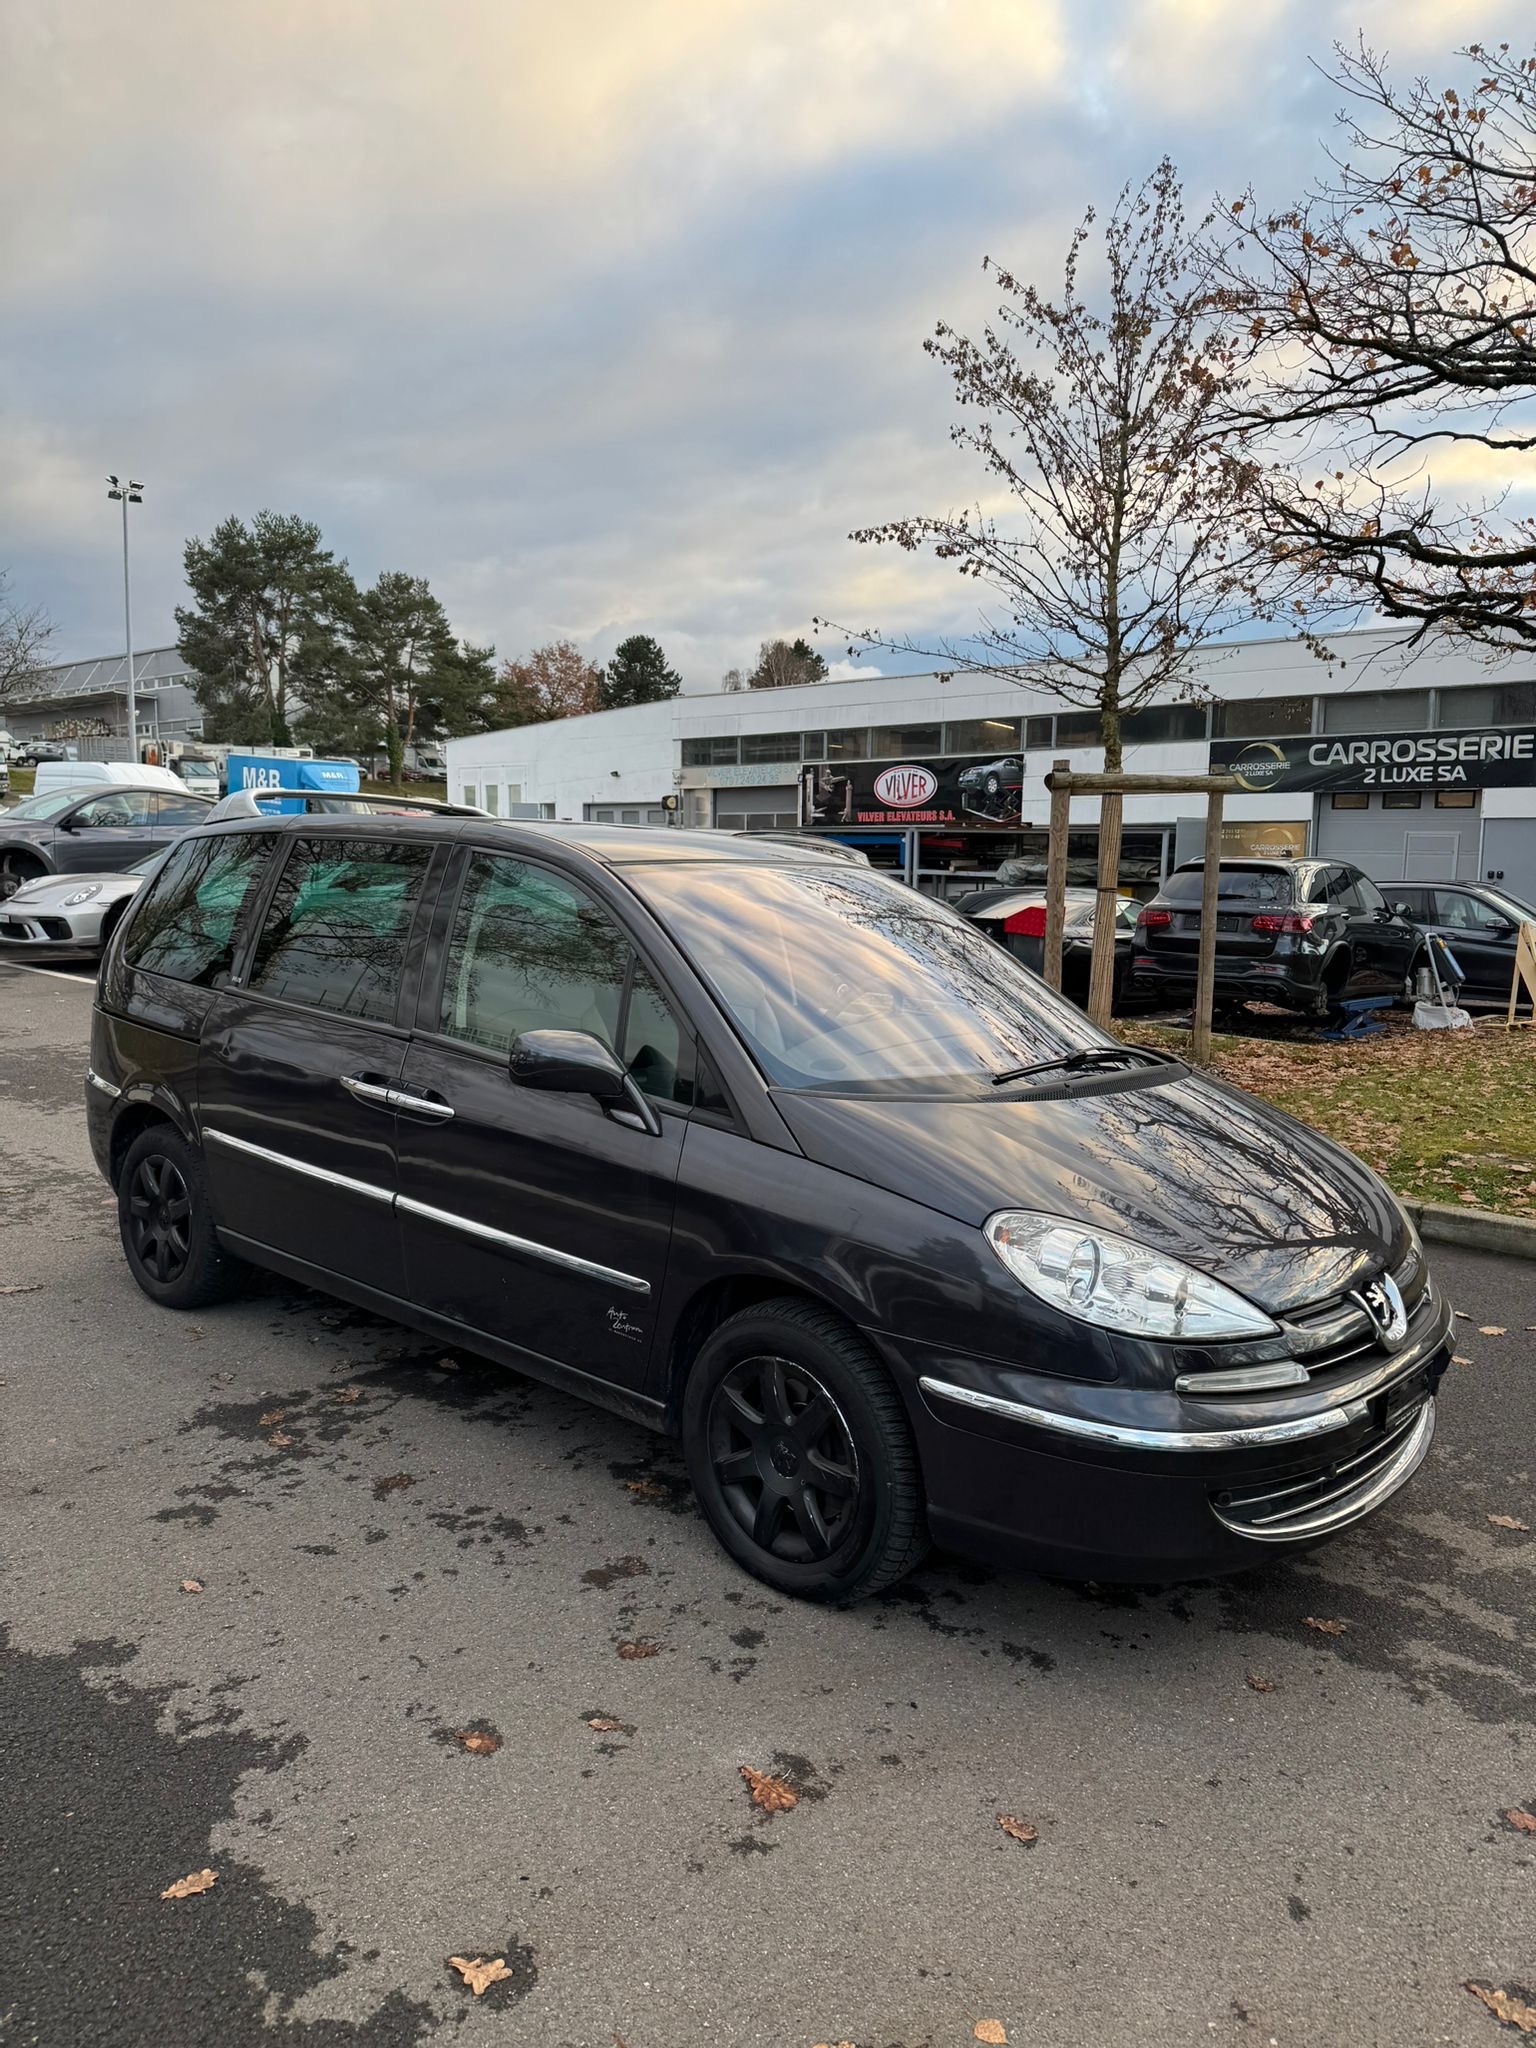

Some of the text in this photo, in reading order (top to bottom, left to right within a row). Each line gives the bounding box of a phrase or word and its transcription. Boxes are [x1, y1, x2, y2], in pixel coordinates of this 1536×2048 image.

[1308, 734, 1535, 766] CARROSSERIE
[1229, 761, 1291, 772] CARROSSERIE
[1363, 765, 1467, 784] 2 LUXE SA
[242, 766, 281, 789] M&R
[857, 811, 884, 822] VILVER
[887, 810, 937, 822] ELEVATEURS
